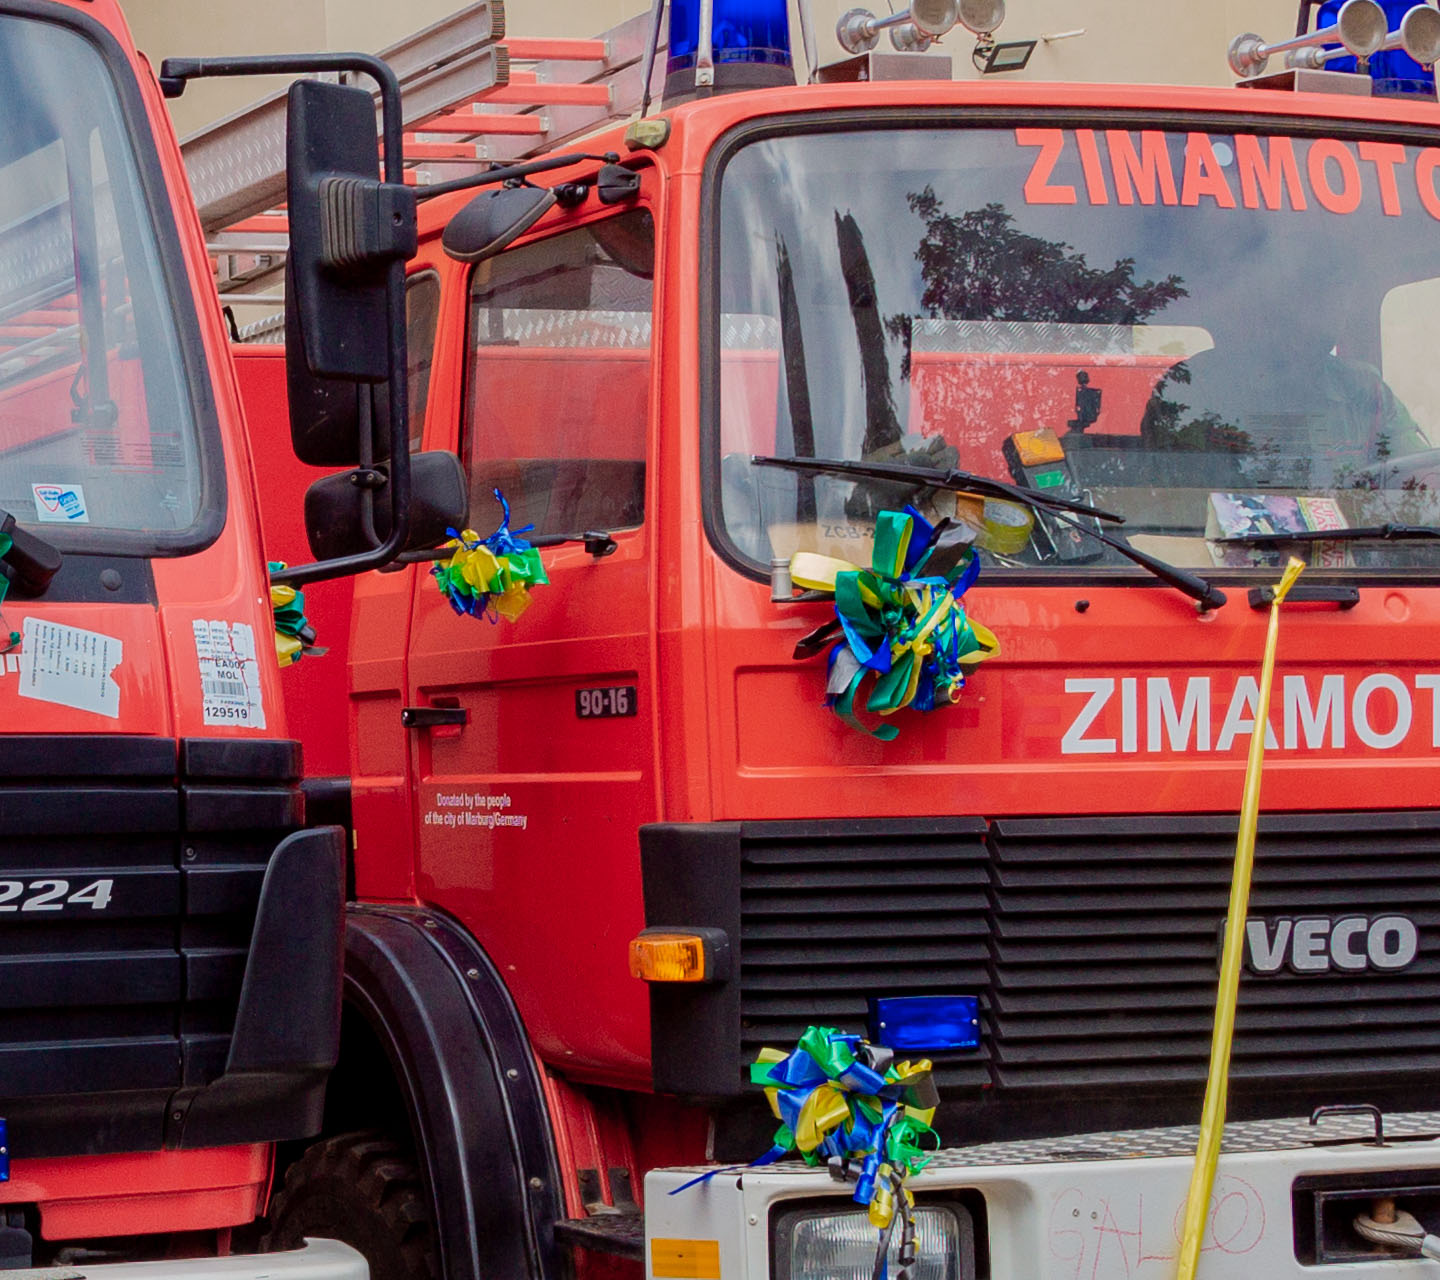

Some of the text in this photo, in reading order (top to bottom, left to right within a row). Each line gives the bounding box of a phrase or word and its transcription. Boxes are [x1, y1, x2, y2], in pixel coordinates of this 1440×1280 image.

[217, 670, 239, 680] MOL
[205, 706, 248, 719] 129519
[436, 793, 511, 810] Donated by the people
[424, 811, 432, 825] of
[432, 811, 443, 825] the
[444, 812, 456, 828] city
[457, 811, 464, 825] of
[1225, 916, 1418, 972] VECO
